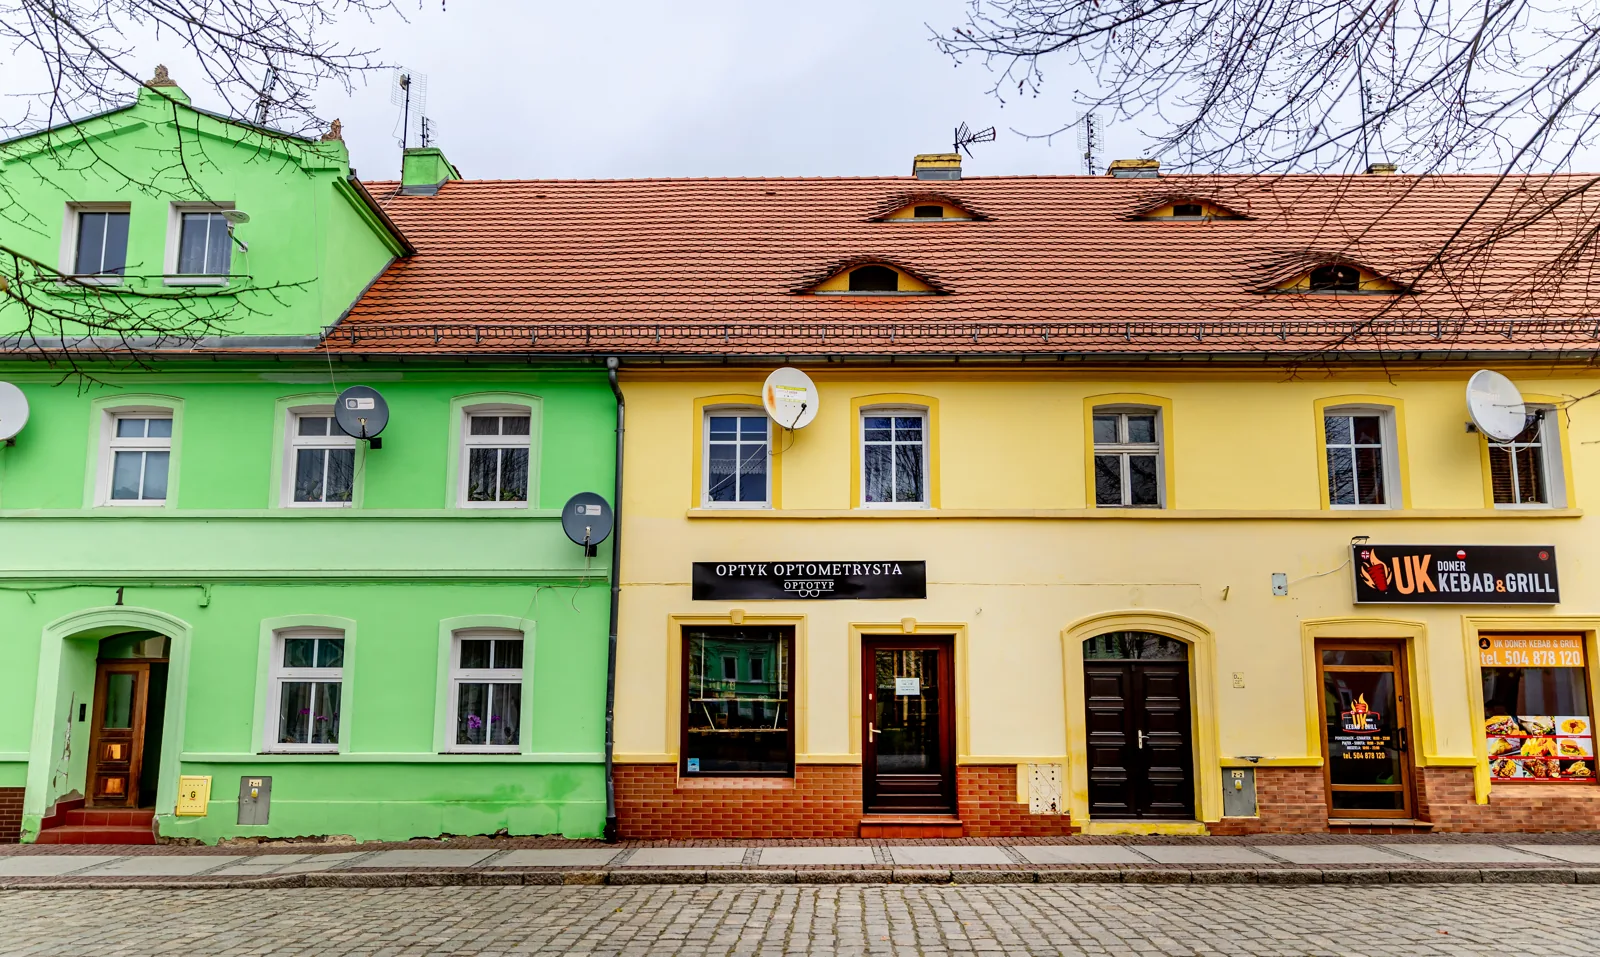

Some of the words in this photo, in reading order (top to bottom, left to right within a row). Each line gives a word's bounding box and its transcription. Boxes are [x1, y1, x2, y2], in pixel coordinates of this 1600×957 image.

[716, 564, 768, 576] OPTYK
[774, 563, 903, 576] OPTOMETRYSTA
[1437, 561, 1466, 572] DONER
[1392, 554, 1437, 595] UK
[784, 581, 835, 590] OPTOTYP
[115, 586, 124, 605] 1
[1493, 639, 1502, 648] UK
[1505, 639, 1527, 648] DONER
[1529, 639, 1551, 648] KEBAB
[1553, 639, 1559, 648] &
[1560, 639, 1580, 648] GRILL
[1481, 651, 1502, 665] tel.
[1505, 650, 1529, 665] 504
[1533, 650, 1556, 665] 878
[1559, 650, 1581, 665] 120
[1353, 752, 1364, 760] 504
[1364, 752, 1375, 760] 878
[1375, 752, 1386, 760] 120
